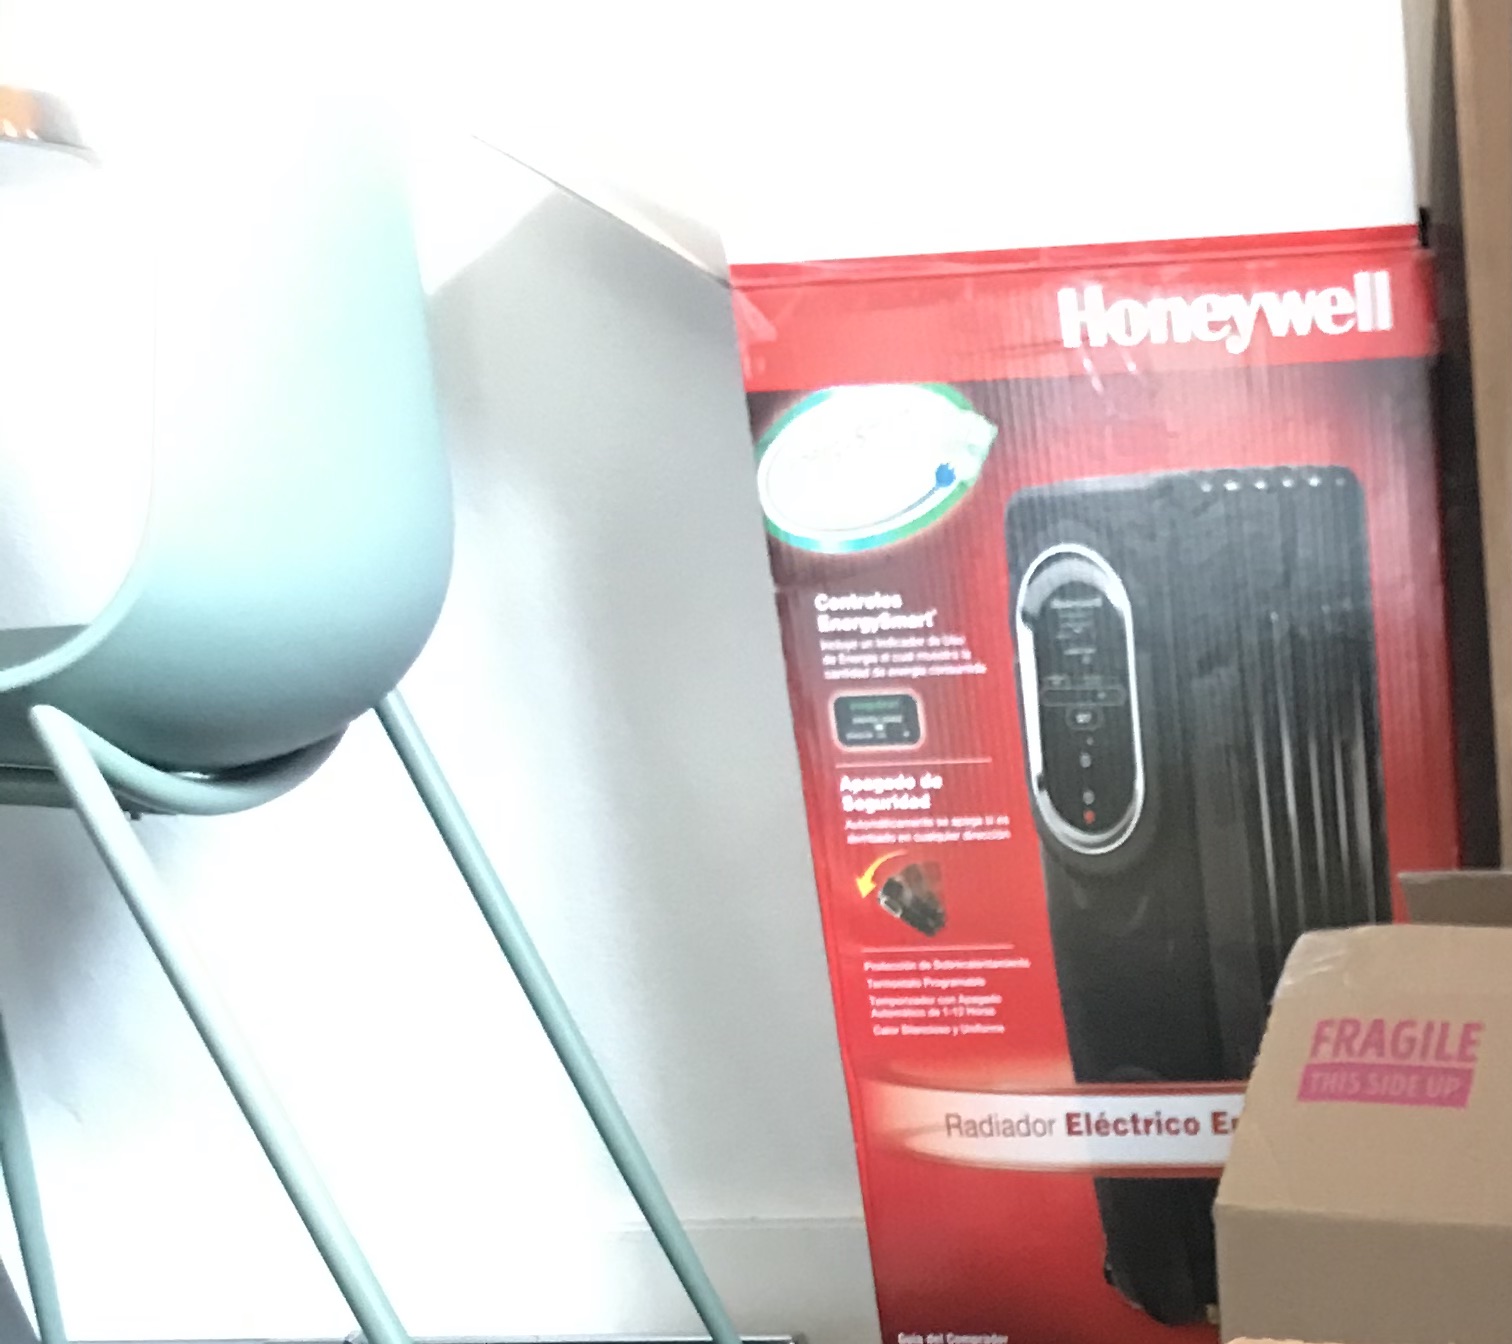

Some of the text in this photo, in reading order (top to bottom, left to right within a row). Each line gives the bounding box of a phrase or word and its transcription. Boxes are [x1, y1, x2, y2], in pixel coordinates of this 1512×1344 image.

[1057, 270, 1392, 354] Honeywell
[814, 592, 903, 611] Controles
[840, 771, 943, 794] Apagado de
[842, 792, 931, 814] Seguridad
[1309, 1017, 1485, 1063] FRAGILE
[1309, 1071, 1461, 1099] THIS SIDE UP
[945, 1112, 1055, 1138] Radiador
[1065, 1110, 1200, 1136] Eléctrico
